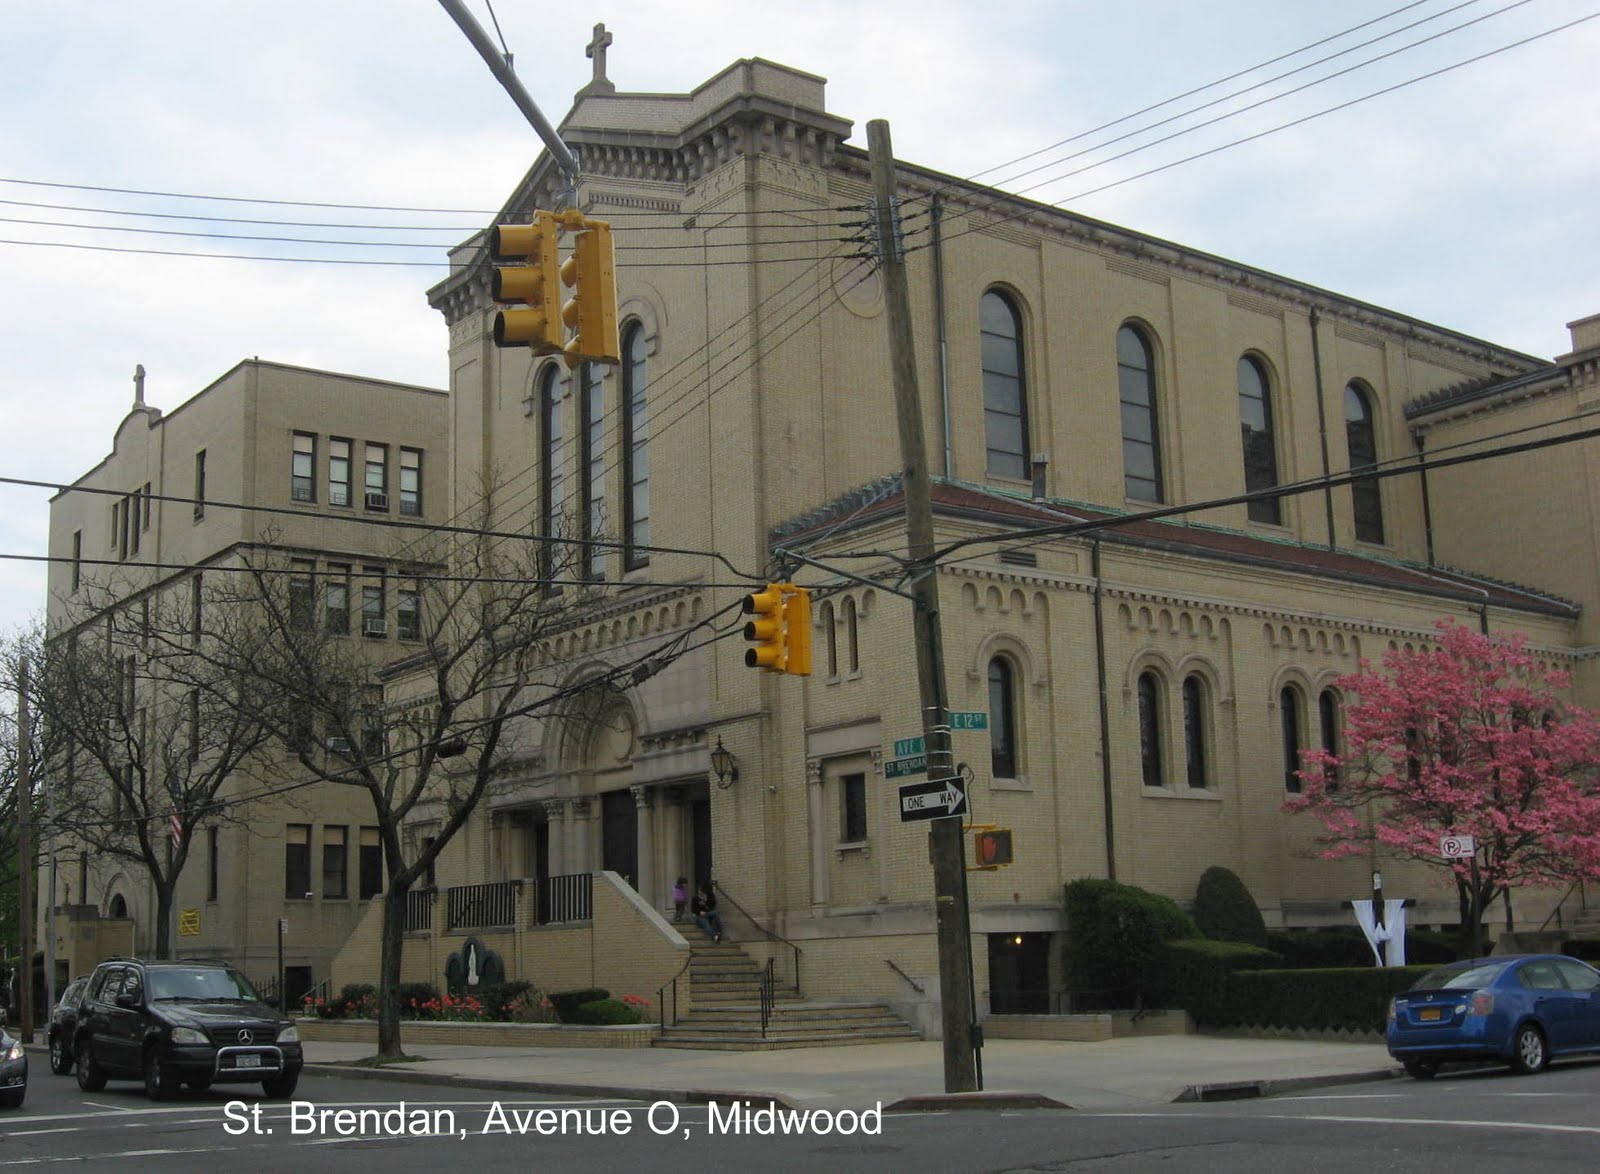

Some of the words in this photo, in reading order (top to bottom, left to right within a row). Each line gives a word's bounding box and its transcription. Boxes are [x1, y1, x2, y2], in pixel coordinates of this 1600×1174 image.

[954, 714, 961, 728] E
[897, 740, 914, 756] AVE
[887, 763, 894, 774] ST
[897, 757, 927, 771] BRENDAN
[908, 796, 925, 809] ONE
[940, 791, 958, 804] WAY
